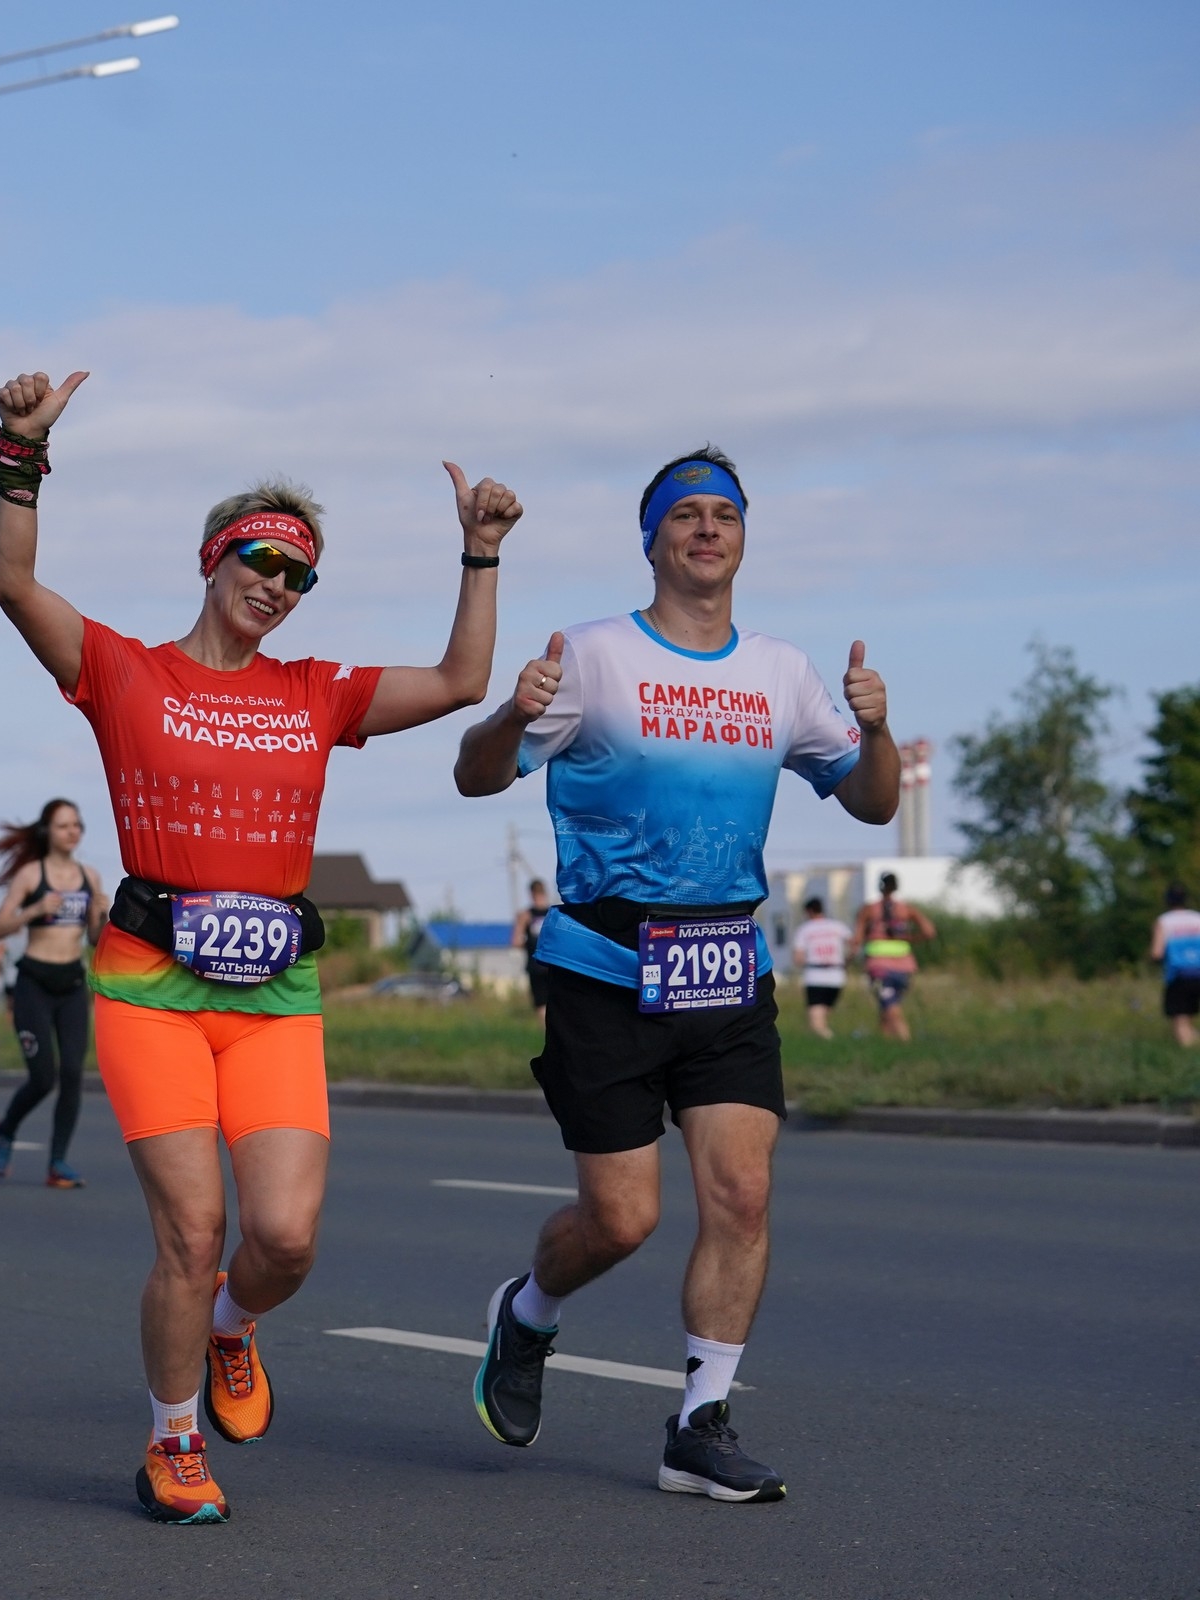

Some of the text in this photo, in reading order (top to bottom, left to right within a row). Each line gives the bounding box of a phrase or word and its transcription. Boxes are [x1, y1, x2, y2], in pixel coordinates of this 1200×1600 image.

[188, 691, 286, 708] АЛЬФА-БАНК
[638, 682, 770, 716] САМАРСКИЙ
[162, 696, 312, 730] САМАРСКИЙ
[640, 705, 772, 725] МЕЖДУНАРОДНЫЙ
[162, 715, 319, 753] МАРАФОН
[641, 715, 773, 750] МАРАФОН
[216, 898, 291, 915] МАРАФОН
[199, 914, 288, 961] 2239
[678, 924, 750, 938] МАРАФОН
[178, 937, 194, 945] 21,1
[210, 961, 271, 974] ТАТЬЯНА
[667, 940, 743, 986] 2198
[646, 988, 657, 999] D
[667, 985, 743, 1000] АЛЕКСАНДР
